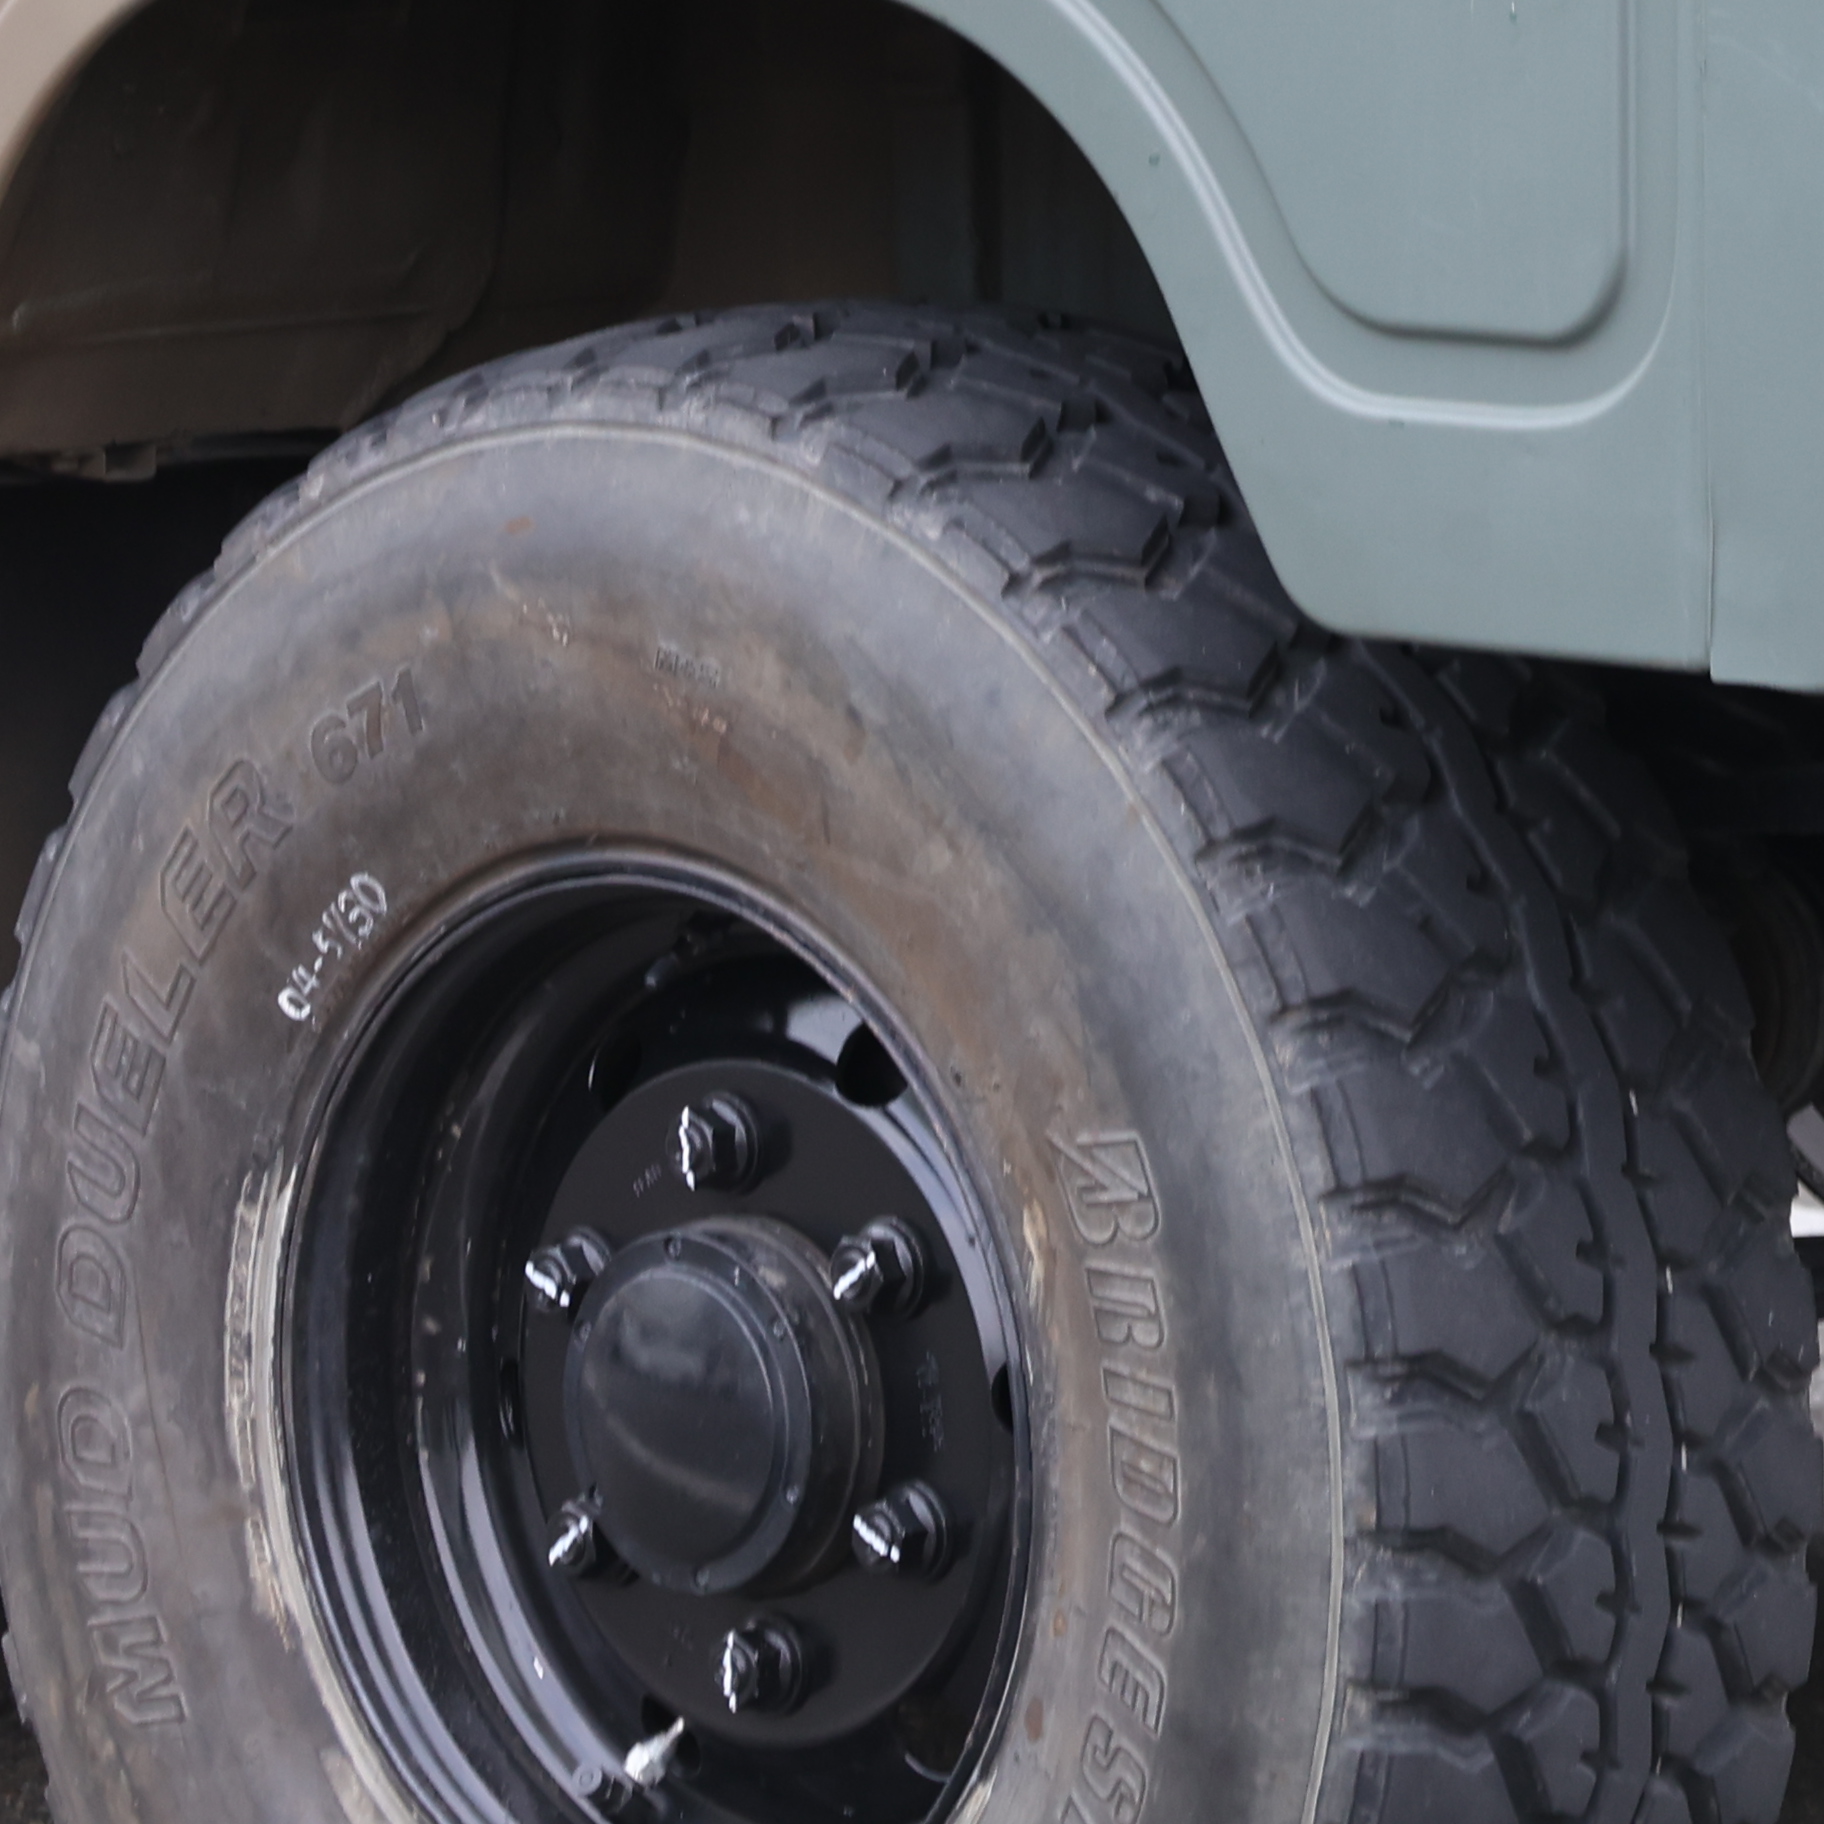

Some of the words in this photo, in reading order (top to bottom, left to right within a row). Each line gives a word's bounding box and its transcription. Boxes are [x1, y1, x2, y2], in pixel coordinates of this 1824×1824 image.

[308, 664, 429, 785] 671
[56, 758, 294, 1351] DUELER
[56, 1386, 189, 1727] MUD
[1046, 1129, 1184, 1823] BRIDGES
